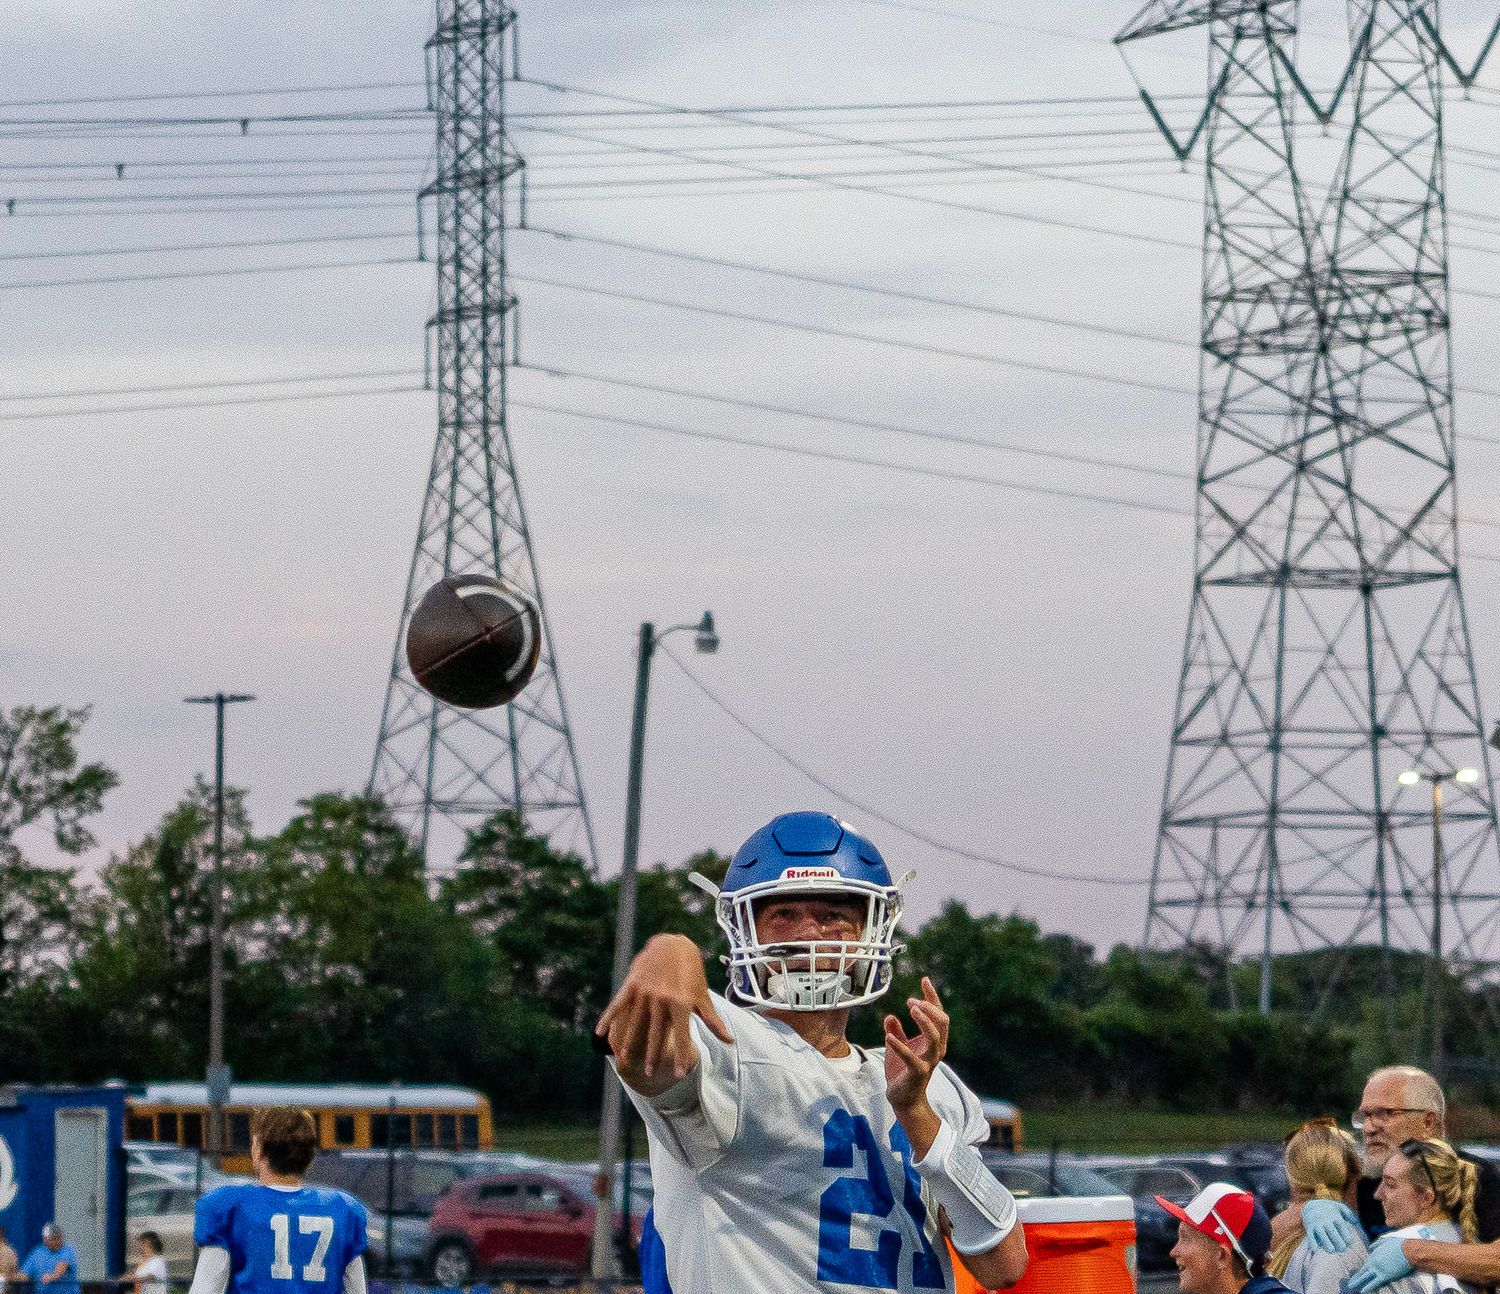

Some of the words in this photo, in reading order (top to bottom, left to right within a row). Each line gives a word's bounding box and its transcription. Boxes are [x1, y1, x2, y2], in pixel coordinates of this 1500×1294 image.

[786, 869, 834, 879] Riddell
[817, 1107, 946, 1289] 21
[270, 1213, 334, 1282] 17
